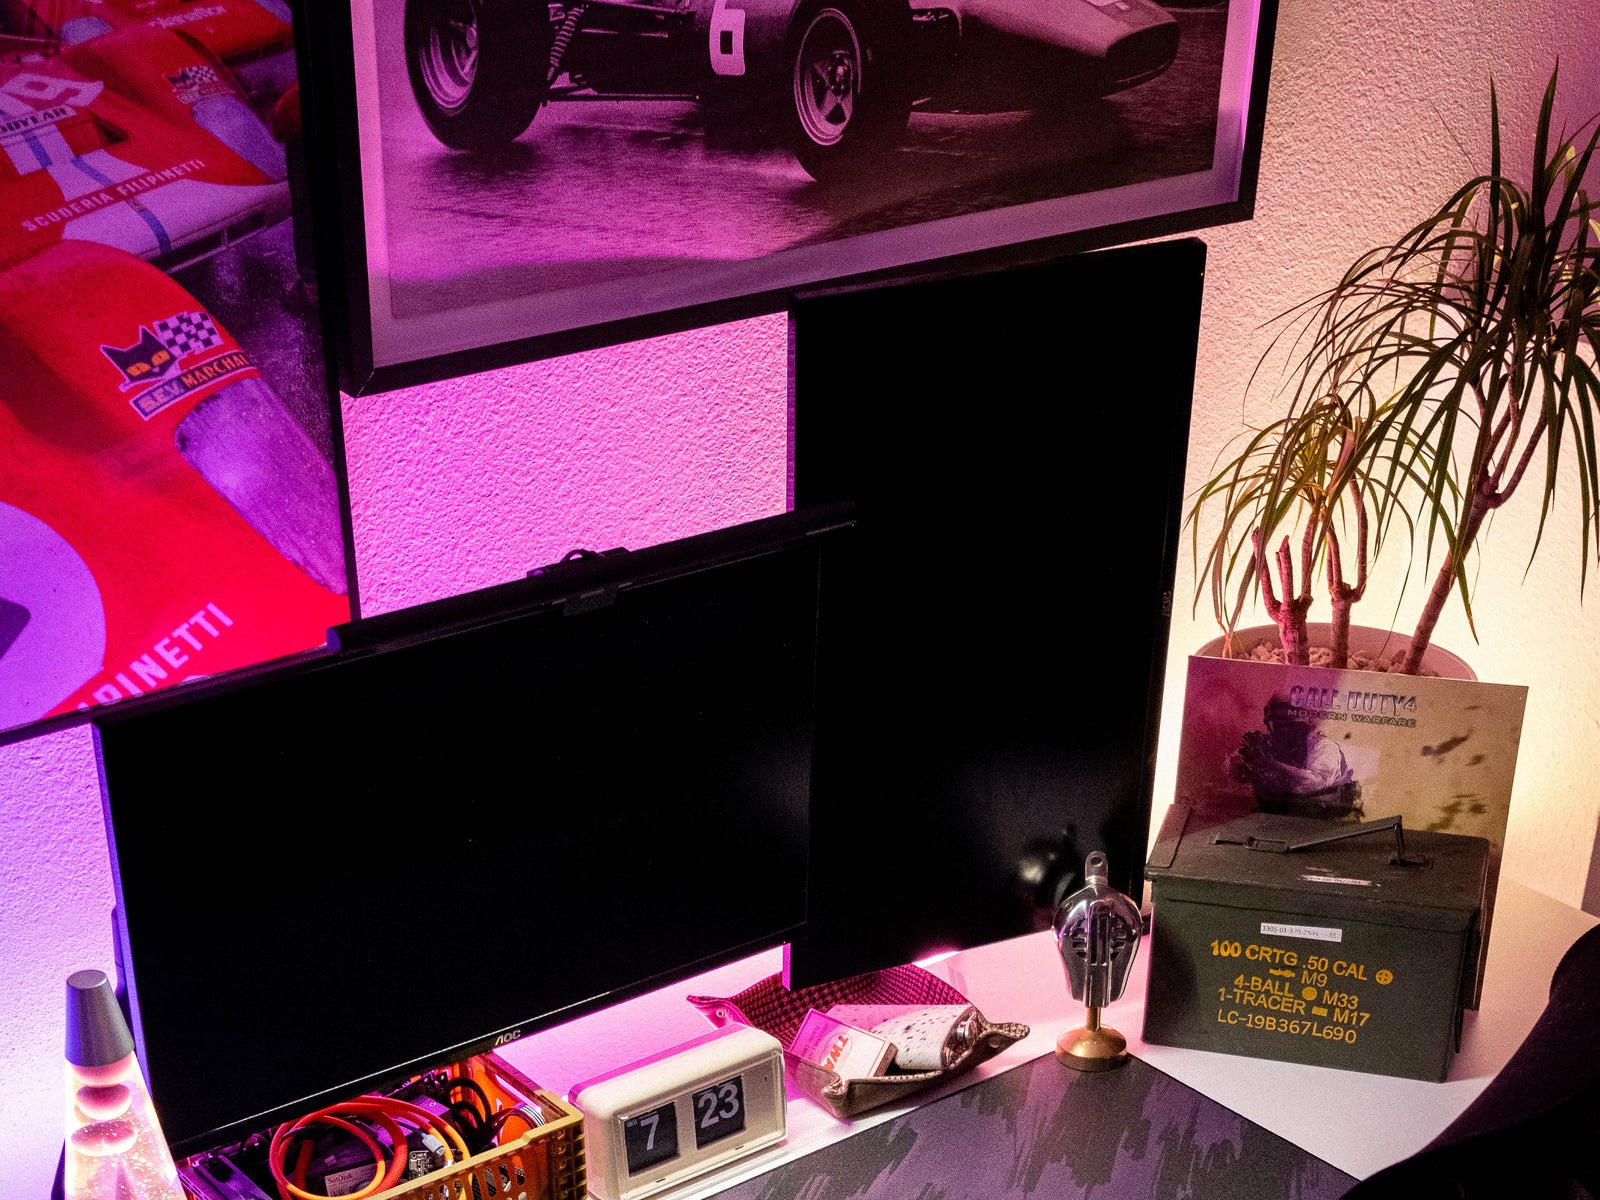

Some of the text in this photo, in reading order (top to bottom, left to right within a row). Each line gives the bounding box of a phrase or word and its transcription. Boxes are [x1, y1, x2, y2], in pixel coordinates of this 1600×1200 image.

[709, 0, 745, 76] 6
[21, 159, 206, 232] SCUDERIA FILIPINETTI
[77, 602, 234, 711] PINETTI
[1289, 685, 1341, 710] CALL
[1287, 708, 1417, 728] MODERN WARFARE
[1210, 939, 1368, 981] 100 CRTG .50 CAL
[1233, 974, 1359, 1010] 4-BALL M33
[1301, 970, 1328, 987] M9
[1218, 987, 1371, 1027] 1-TRACER M17
[495, 1030, 521, 1046] AOC
[1217, 1009, 1357, 1044] LC-19B367L690
[823, 1034, 850, 1071] TWA
[640, 1083, 740, 1151] 7 23
[328, 1173, 353, 1184] SanDisk
